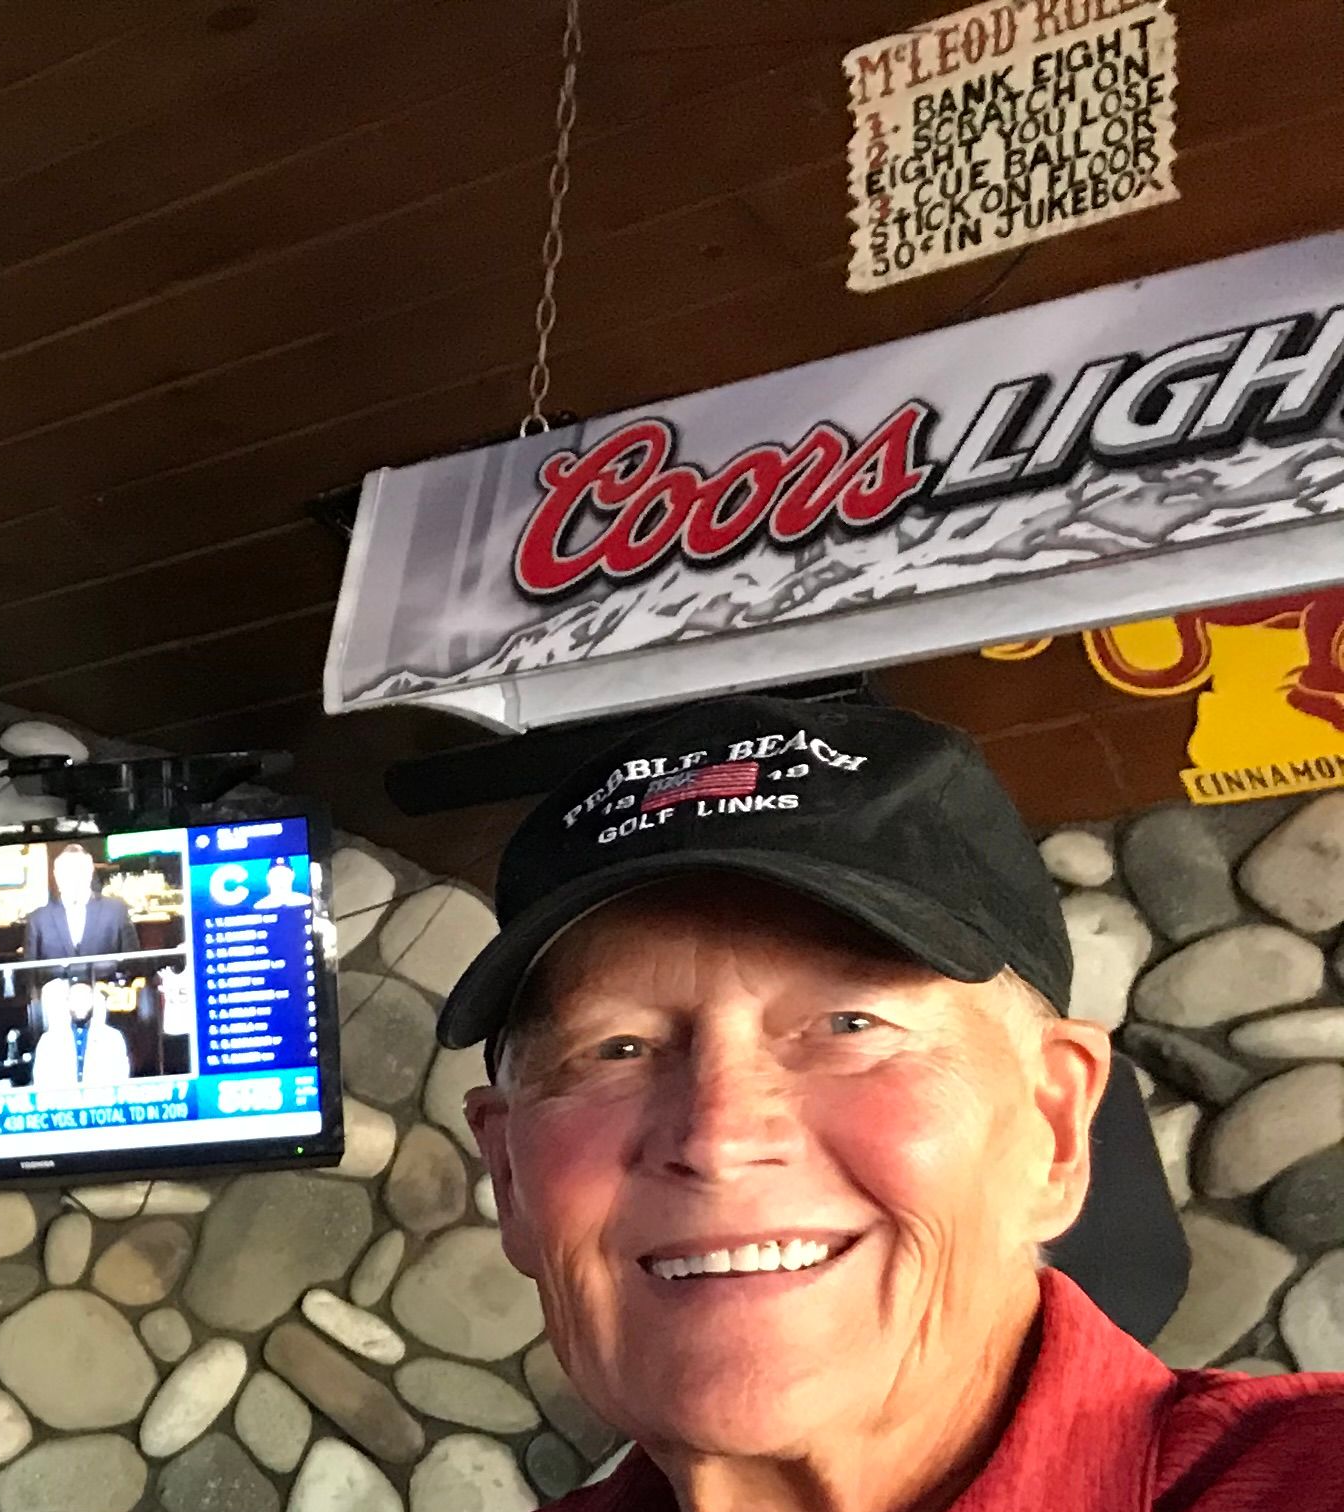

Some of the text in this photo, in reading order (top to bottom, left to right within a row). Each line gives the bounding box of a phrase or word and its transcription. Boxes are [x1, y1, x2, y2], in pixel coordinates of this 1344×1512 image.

[912, 52, 1150, 157] SCRATCH ON
[914, 67, 1024, 127] BANK
[1032, 18, 1156, 86] EIGHT
[865, 74, 1166, 199] EIGHT YOU LOSE
[914, 108, 1157, 210] CUE BALL OR
[871, 136, 1160, 251] STICK ON FLOOR
[942, 164, 1164, 255] IN JUKEBOX
[512, 400, 932, 598] Coors
[561, 729, 867, 828] PEBBLE BEACH
[597, 794, 799, 844] GOLF LINKS
[26, 1112, 49, 1130] REC
[89, 1106, 127, 1126] TOTAL
[130, 1104, 145, 1122] TD
